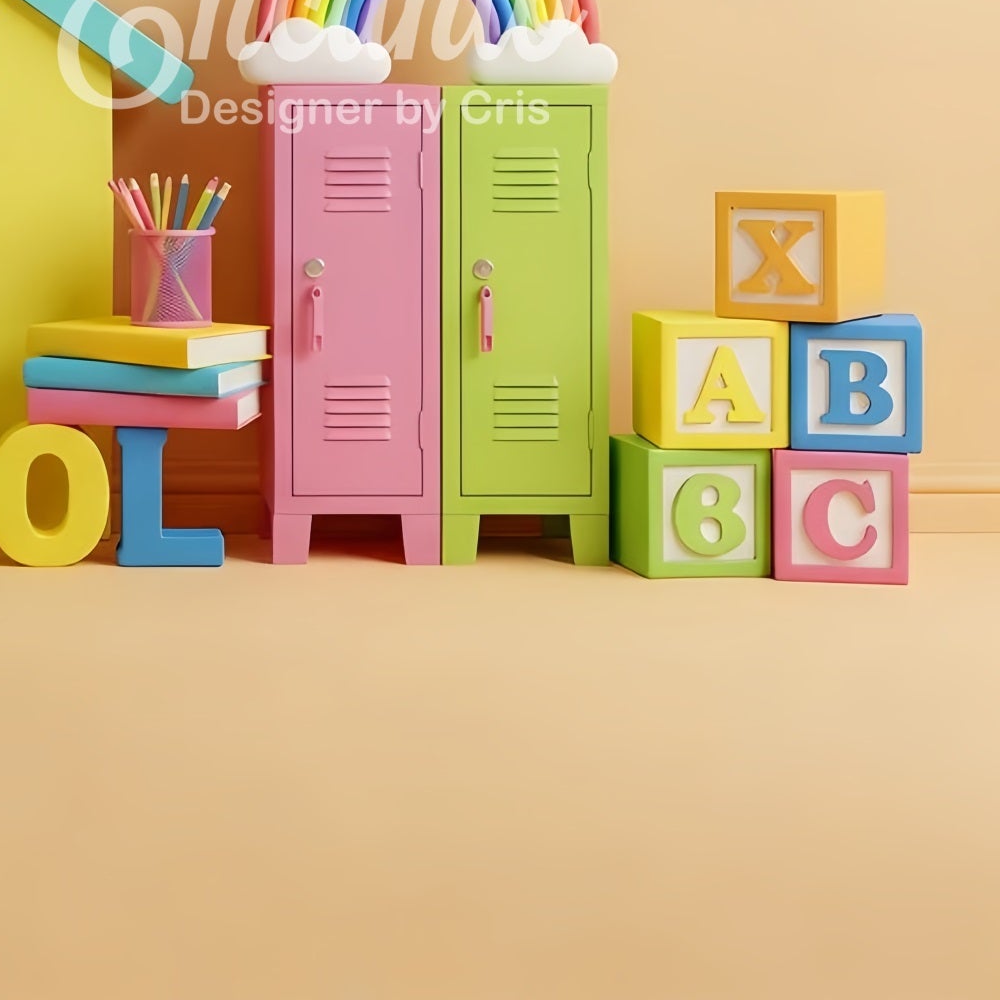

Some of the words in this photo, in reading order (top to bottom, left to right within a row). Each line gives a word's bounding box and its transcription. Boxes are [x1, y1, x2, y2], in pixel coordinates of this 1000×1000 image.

[737, 220, 816, 296] X
[683, 345, 766, 425] A
[819, 349, 893, 426] B
[802, 478, 878, 561] C
